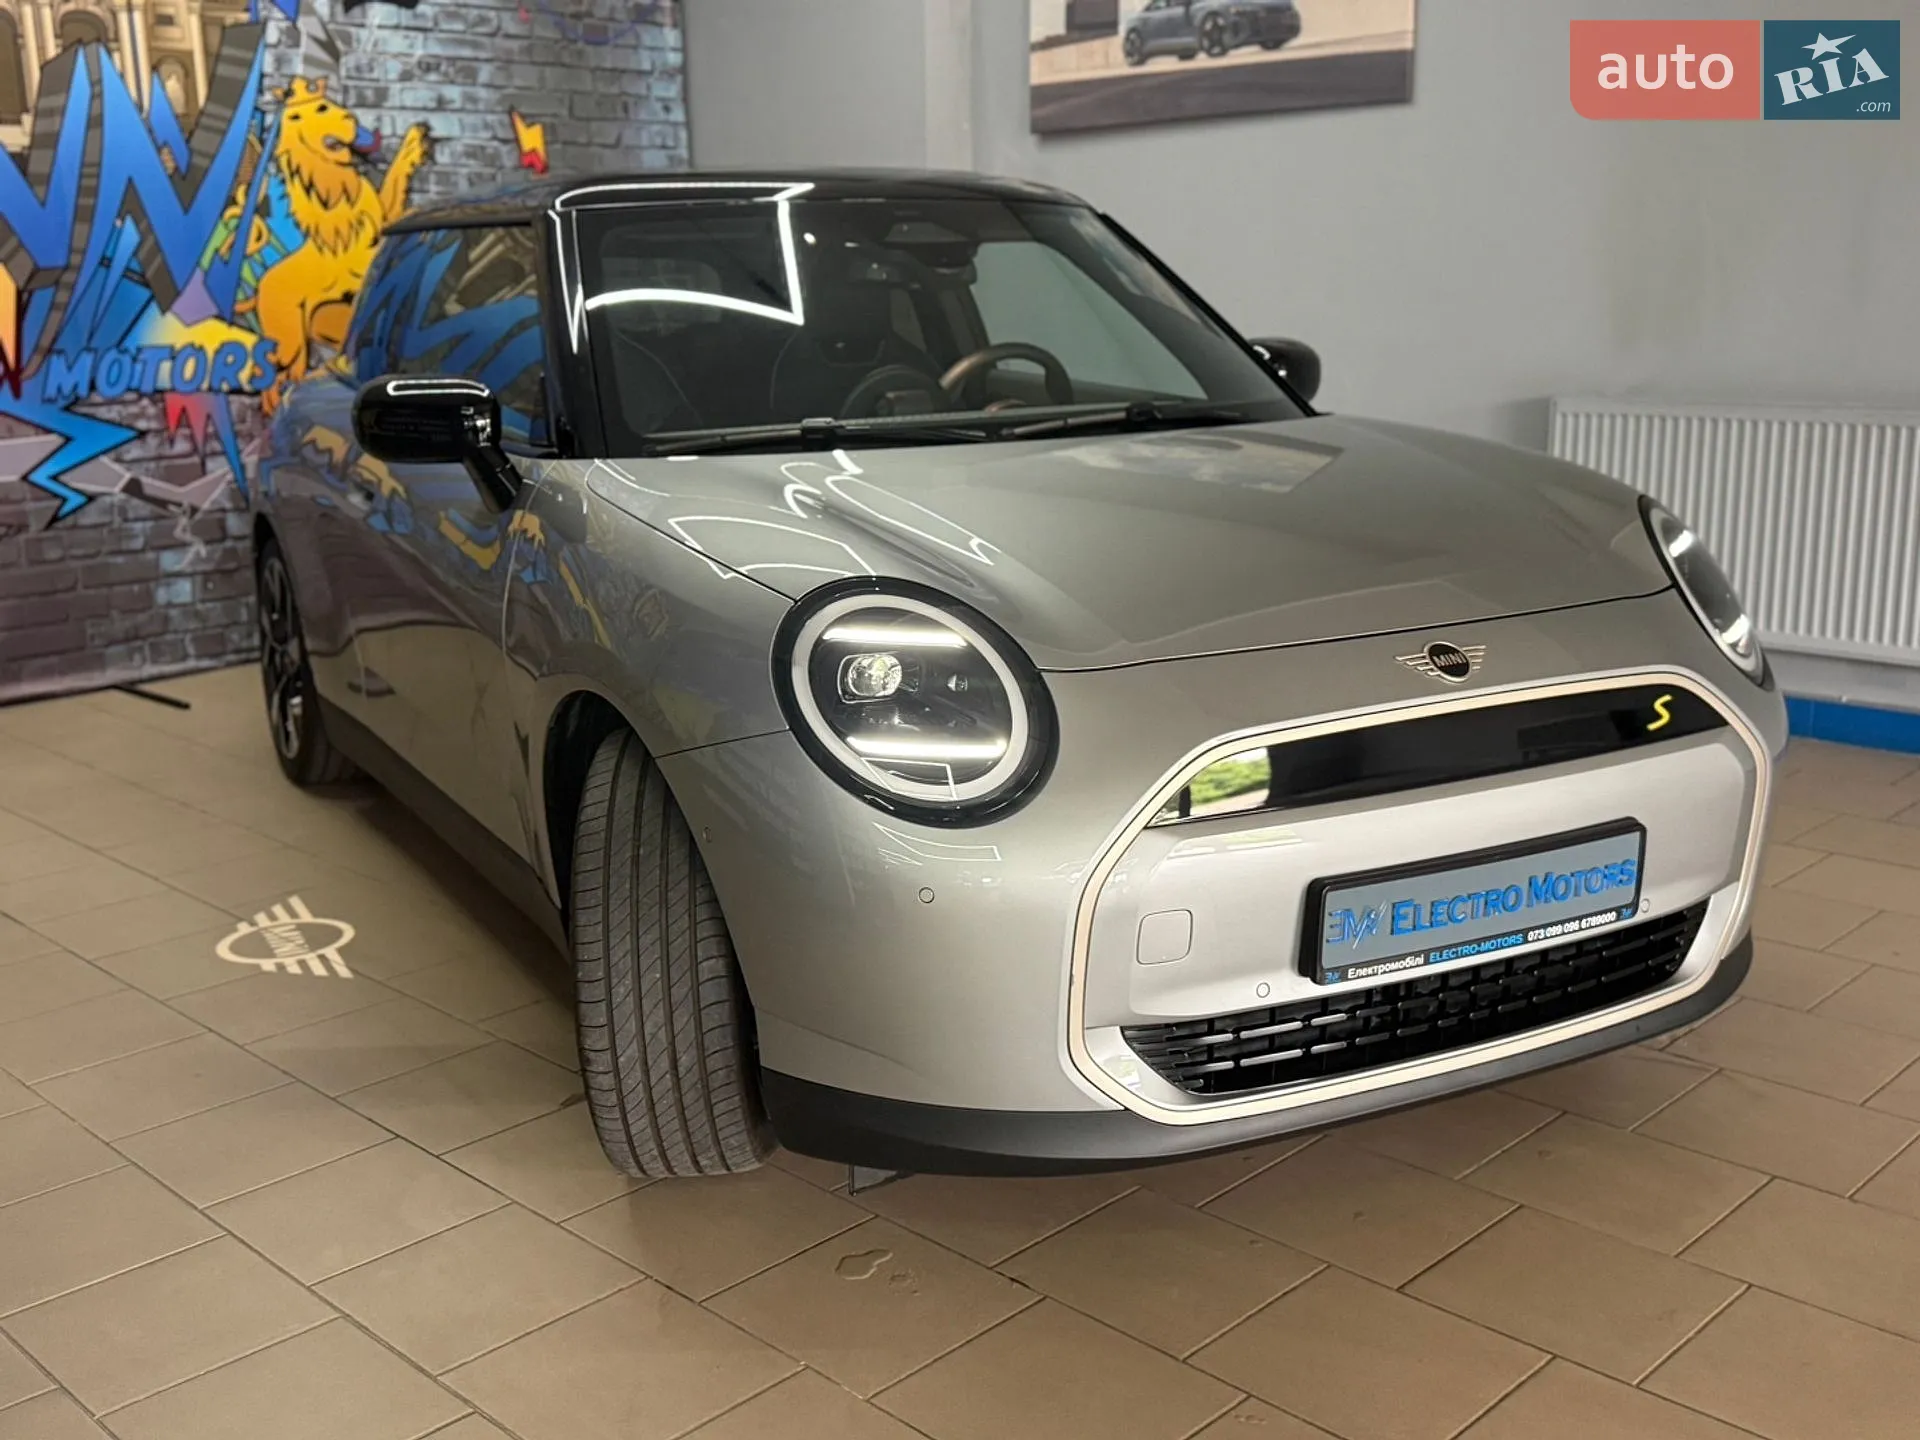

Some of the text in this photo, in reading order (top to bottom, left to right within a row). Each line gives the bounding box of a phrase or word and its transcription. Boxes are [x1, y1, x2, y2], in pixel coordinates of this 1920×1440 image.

[42, 337, 280, 401] MOTORS
[1432, 652, 1467, 669] MINI
[1646, 693, 1673, 731] S
[1390, 884, 1527, 937] ELECTRO
[1527, 858, 1637, 909] MOTORS
[1347, 954, 1425, 980] Електромобілі
[1429, 933, 1525, 964] ELECTRO-MOTORS
[1527, 927, 1546, 942] 073
[1563, 919, 1580, 934] 096
